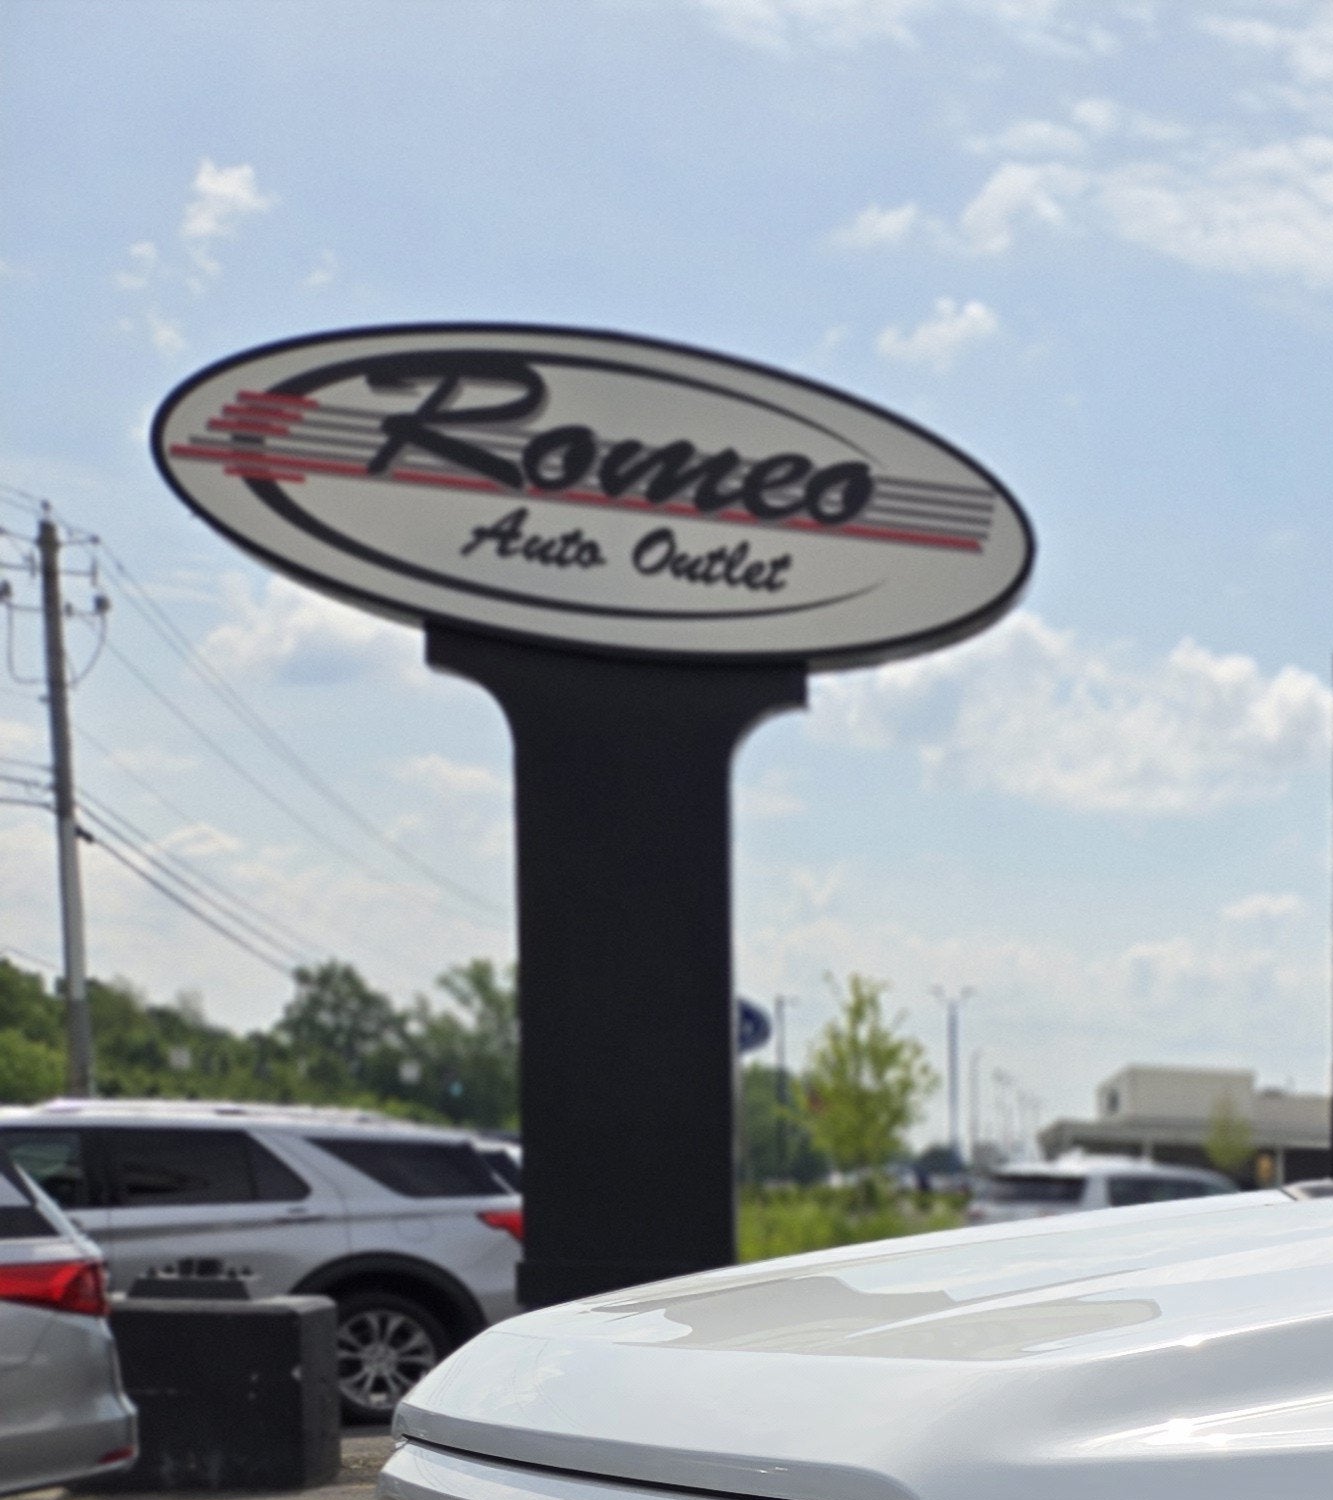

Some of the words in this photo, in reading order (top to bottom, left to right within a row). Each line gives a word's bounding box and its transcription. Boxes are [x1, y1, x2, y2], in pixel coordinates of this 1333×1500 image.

[366, 350, 874, 526] Romeo
[459, 506, 606, 568] Auto
[632, 527, 792, 592] Outlet
